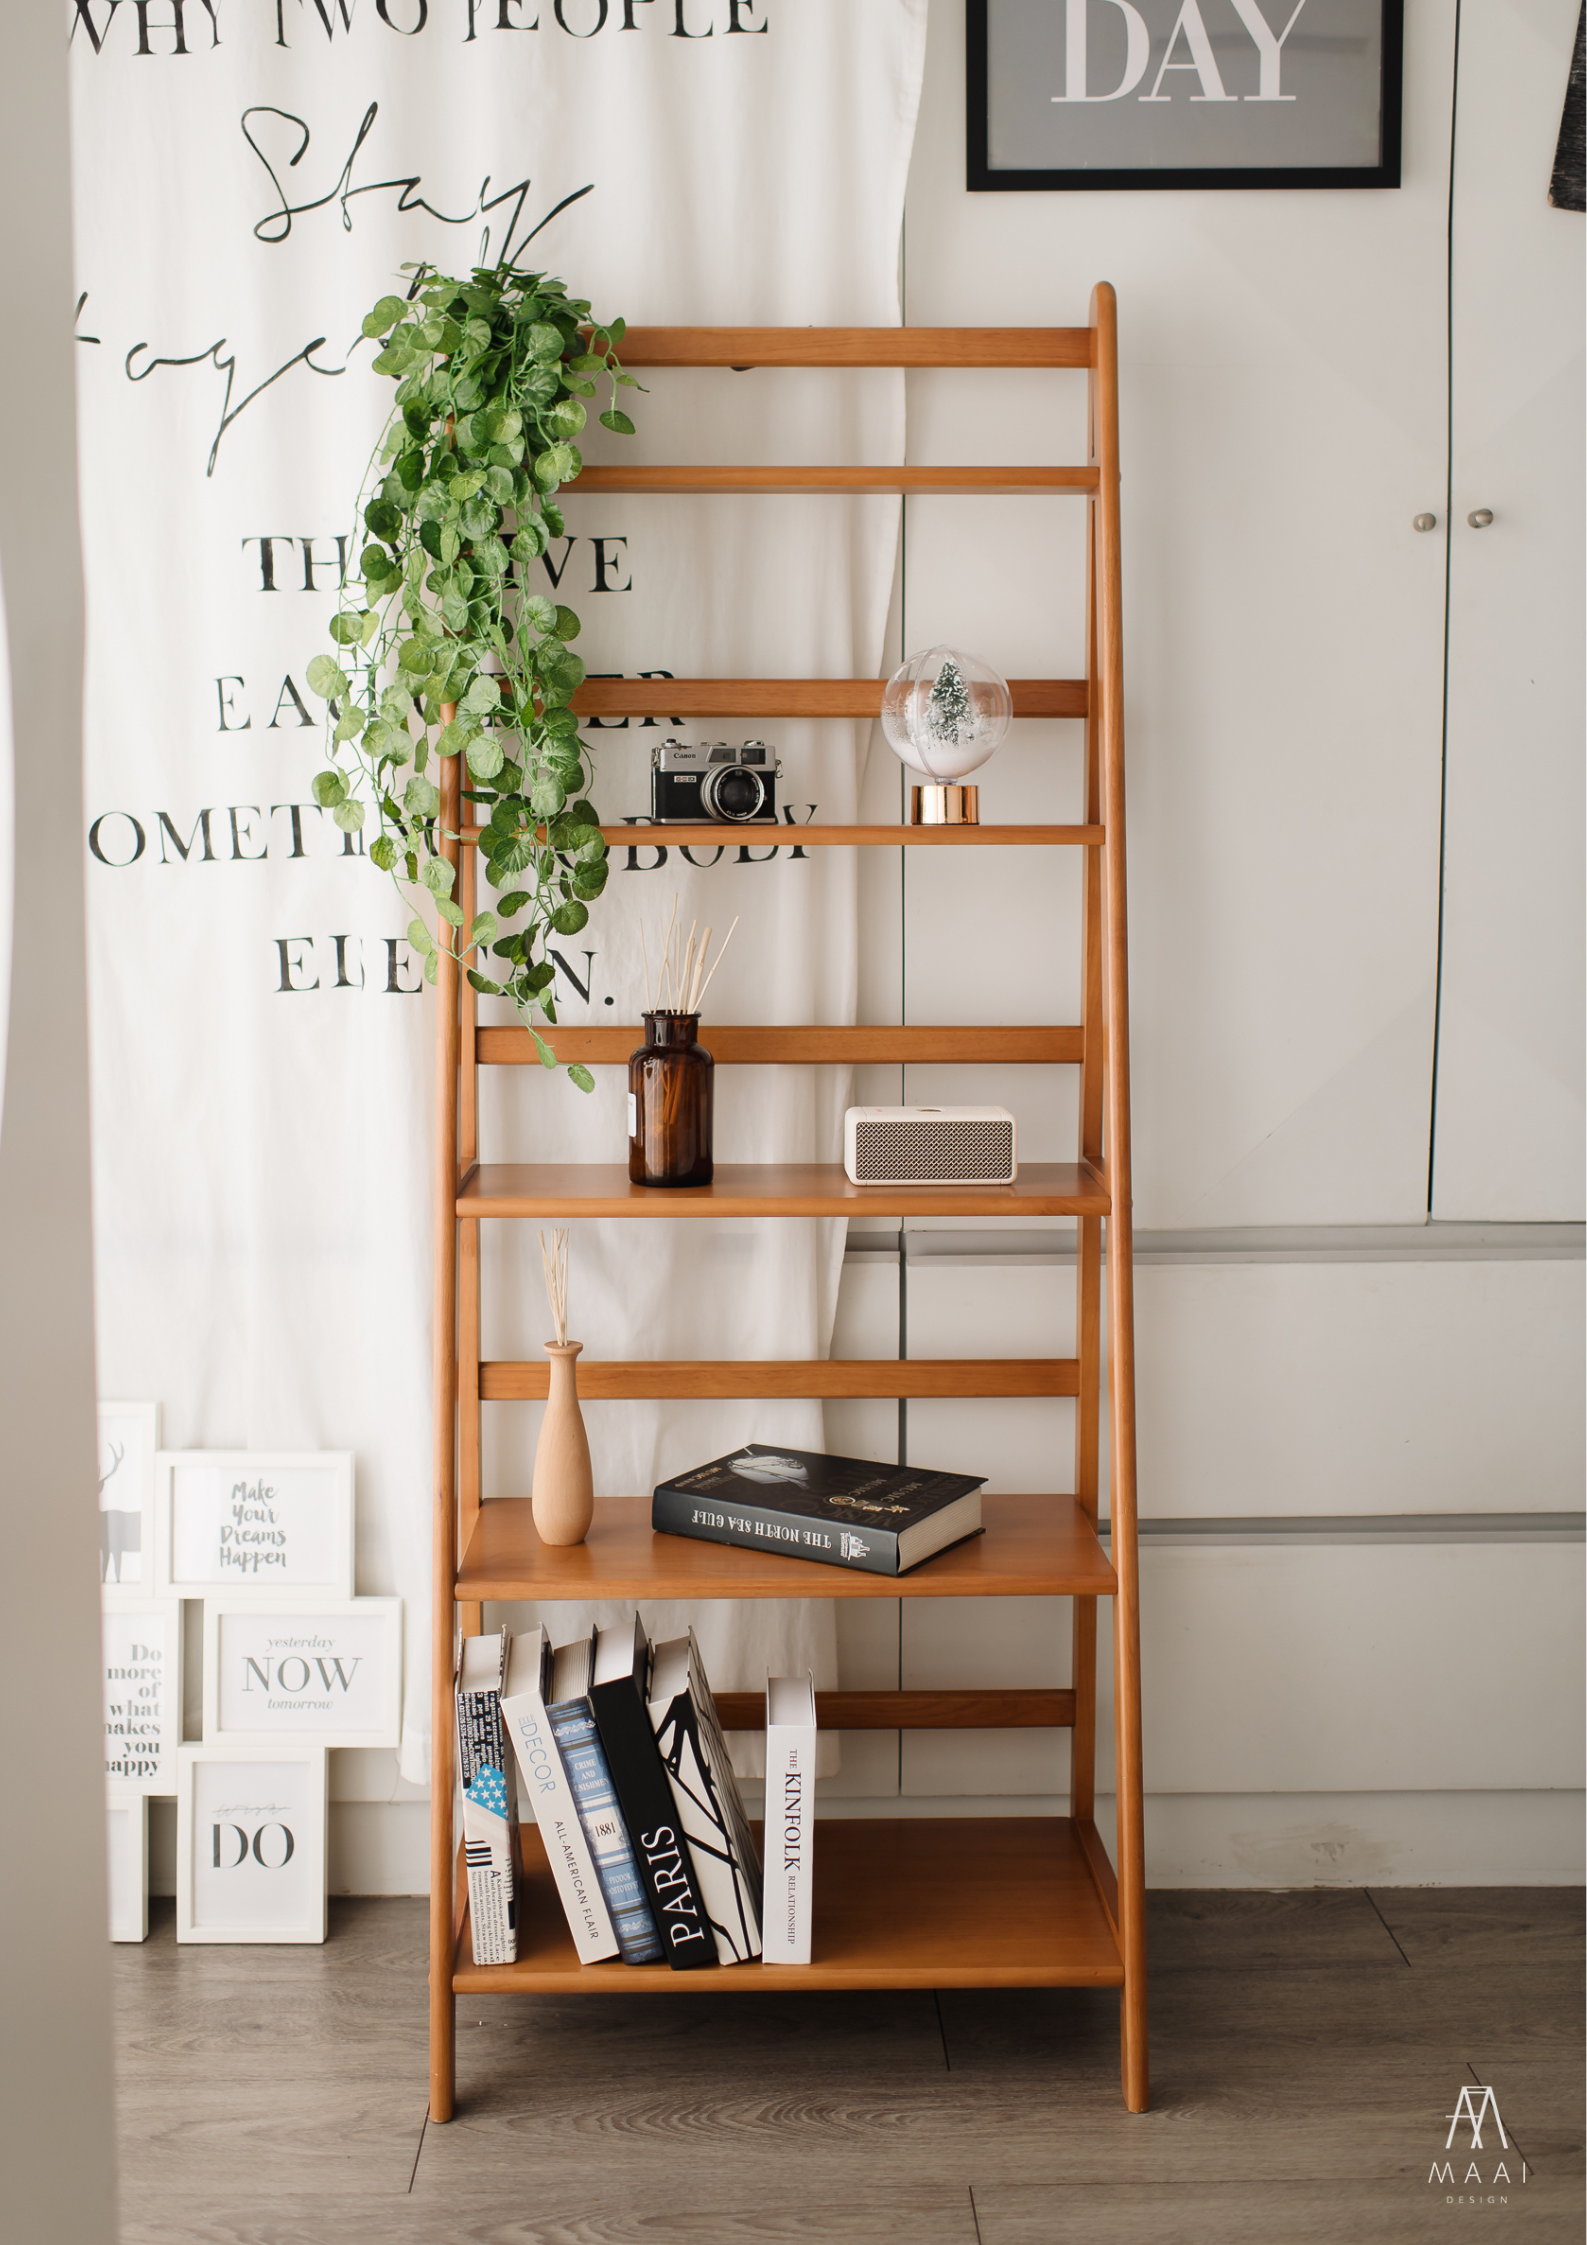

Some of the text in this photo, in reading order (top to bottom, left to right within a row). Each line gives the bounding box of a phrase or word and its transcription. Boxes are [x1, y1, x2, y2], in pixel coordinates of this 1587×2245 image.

[68, 0, 224, 56] WHY
[1051, 0, 1305, 103] DAY
[231, 1478, 279, 1507] Make
[232, 1504, 279, 1526] Your
[691, 1509, 725, 1528] GULF
[727, 1516, 752, 1533] SEA
[221, 1525, 286, 1547] Dreams
[754, 1521, 800, 1543] NORTH
[802, 1530, 832, 1549] THE
[220, 1546, 286, 1573] Happen
[130, 1643, 162, 1661] Do
[265, 1635, 336, 1652] yesterday
[106, 1667, 162, 1680] more
[241, 1656, 363, 1692] NOW
[138, 1681, 162, 1699] of
[109, 1699, 161, 1717] what
[267, 1698, 333, 1710] tomorrow
[517, 1714, 536, 1726] ELLE
[122, 1741, 160, 1758] you
[520, 1722, 556, 1794] DECOR
[574, 1758, 597, 1771] CRIME
[581, 1770, 596, 1780] AND
[594, 1821, 616, 1837] 1881
[209, 1822, 295, 1868] DO
[784, 1748, 802, 1944] THE KINFOLK RELATIONSHIP
[490, 1870, 501, 1878] A
[554, 1820, 599, 1939] ALL-AMERICAN FLAIR
[641, 1826, 704, 1947] PARIS
